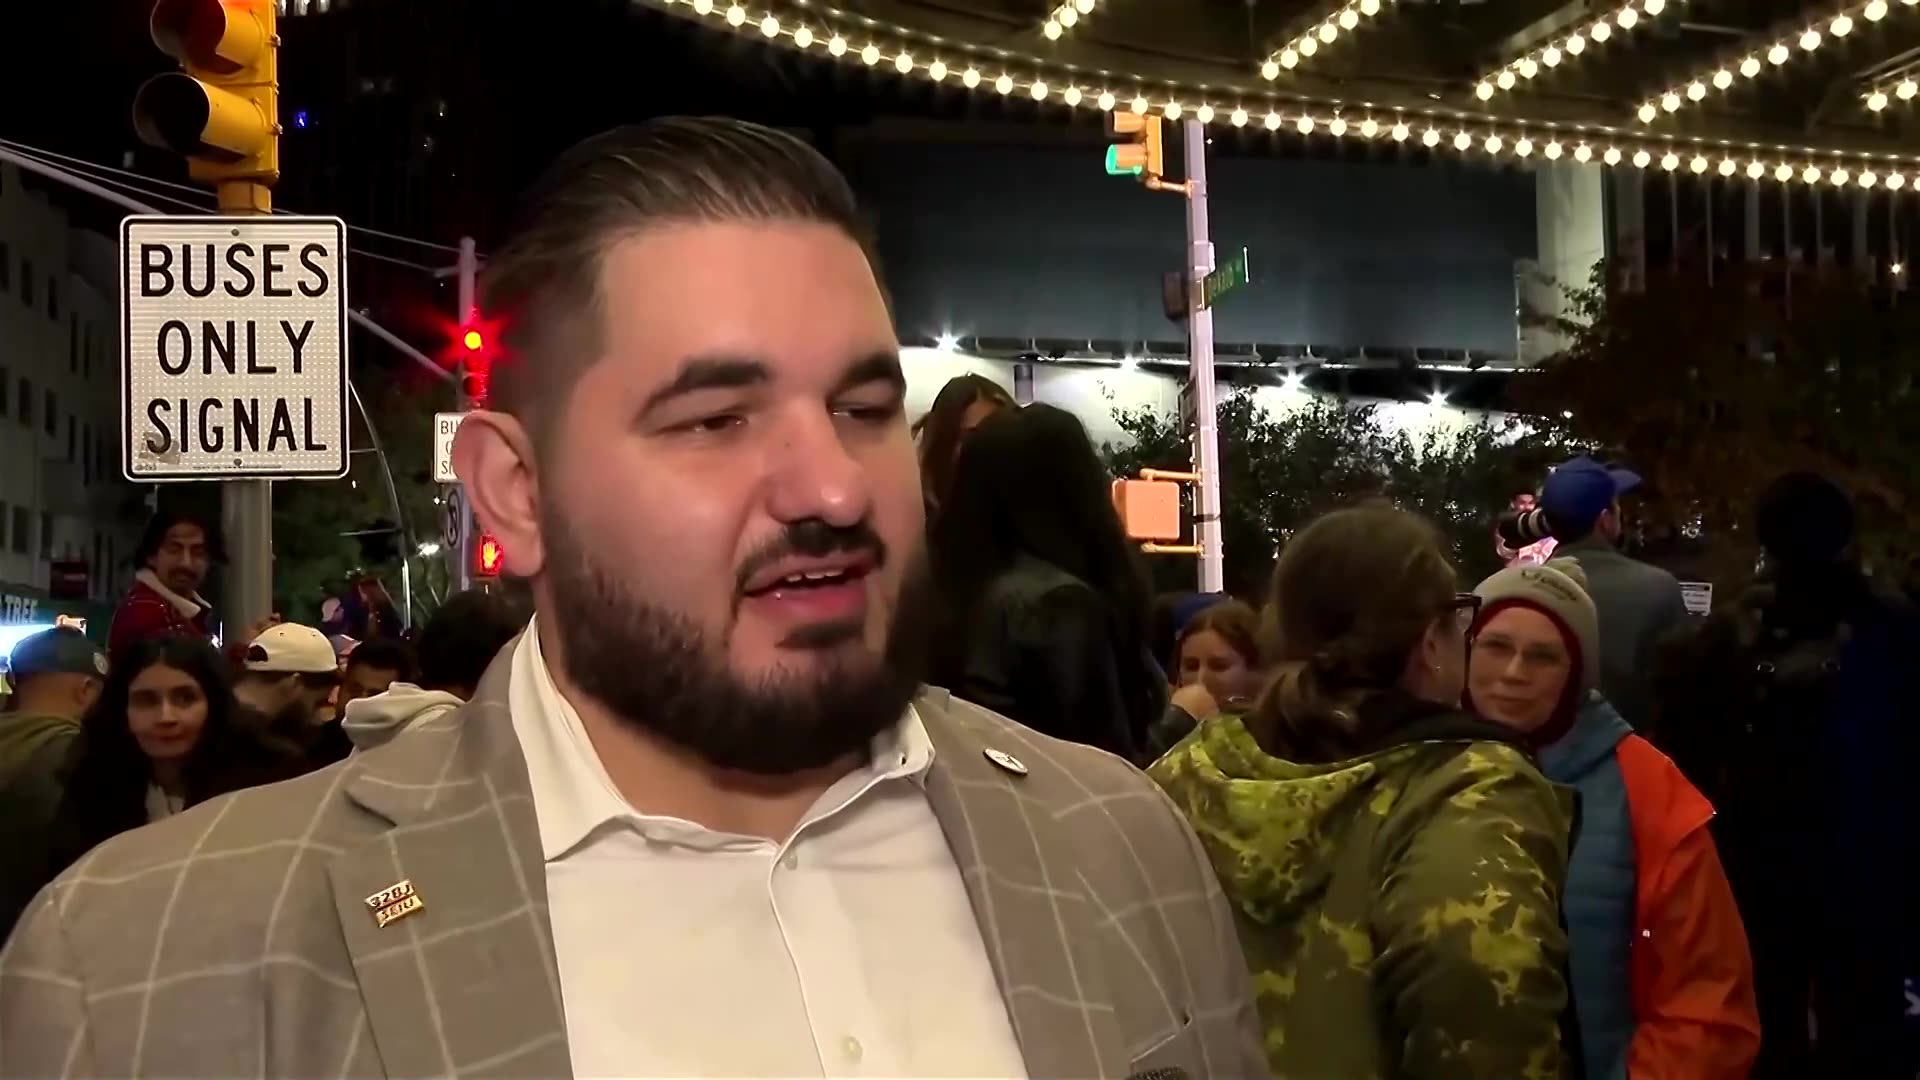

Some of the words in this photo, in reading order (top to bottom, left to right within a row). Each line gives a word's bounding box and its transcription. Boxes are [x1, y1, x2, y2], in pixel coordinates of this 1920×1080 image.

[141, 243, 329, 297] BUSES
[157, 320, 315, 375] ONLY
[146, 398, 327, 453] SIGNAL
